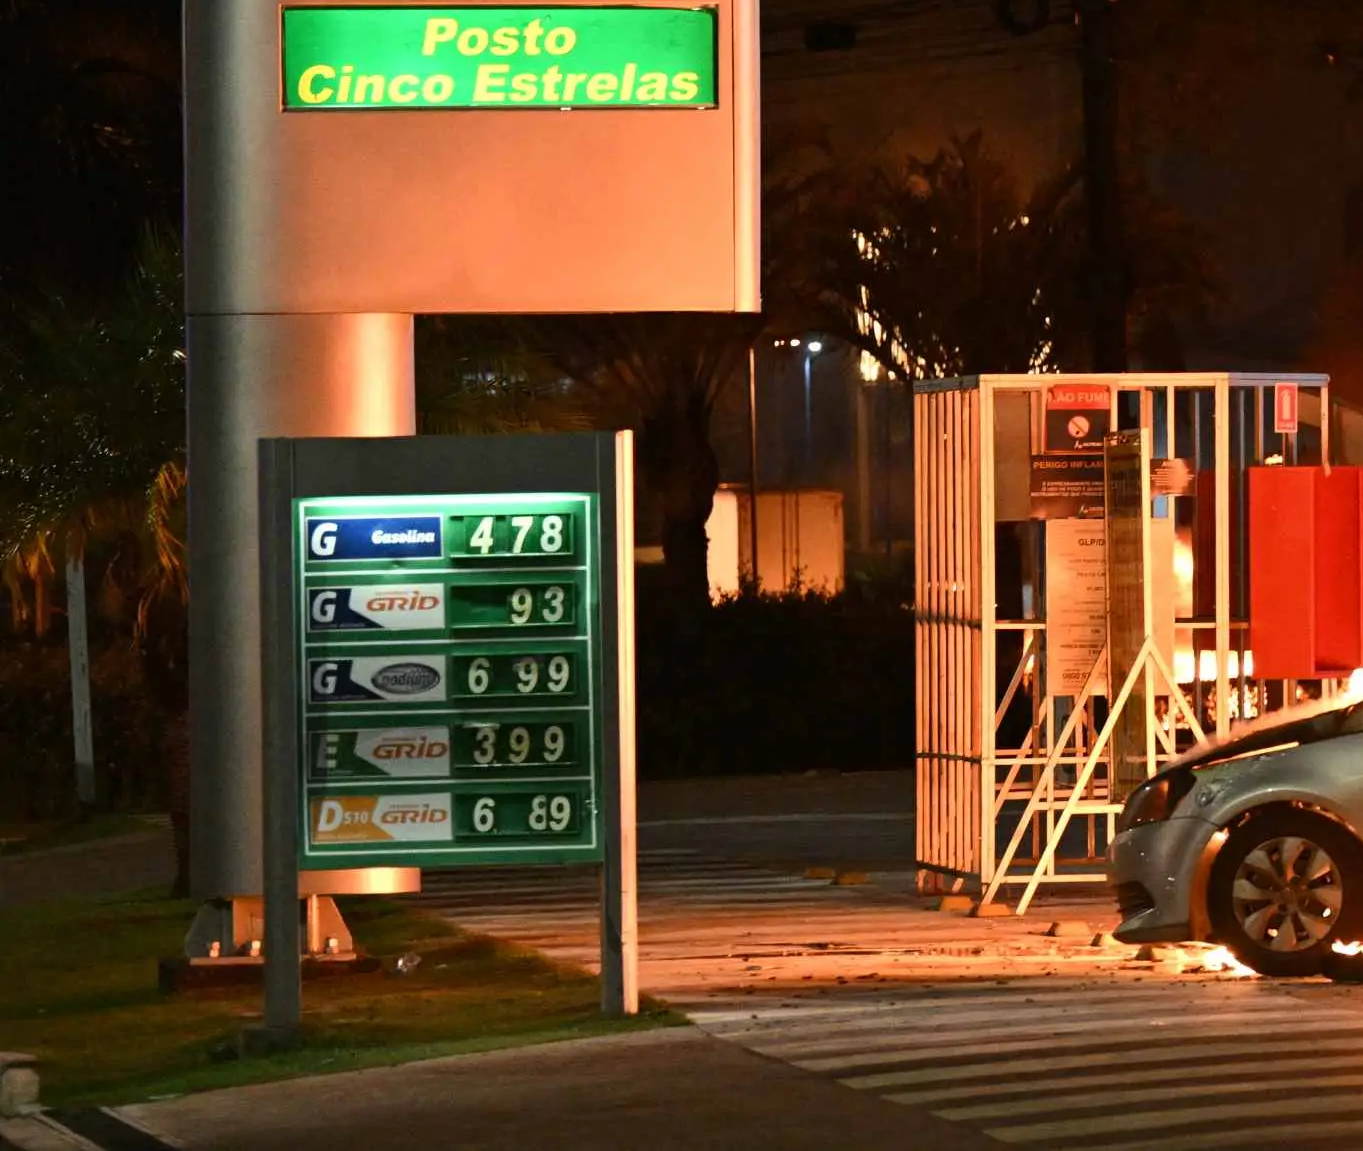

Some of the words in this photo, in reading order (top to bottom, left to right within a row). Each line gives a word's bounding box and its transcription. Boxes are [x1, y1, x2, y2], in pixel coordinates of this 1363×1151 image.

[421, 17, 578, 56] Posto
[297, 64, 455, 103] Cinco
[472, 63, 700, 103] Estrelas
[311, 521, 338, 556] G
[371, 529, 436, 545] Gasolina
[312, 591, 338, 623] G
[313, 663, 338, 694] G
[316, 734, 340, 769] E
[318, 801, 343, 832] D
